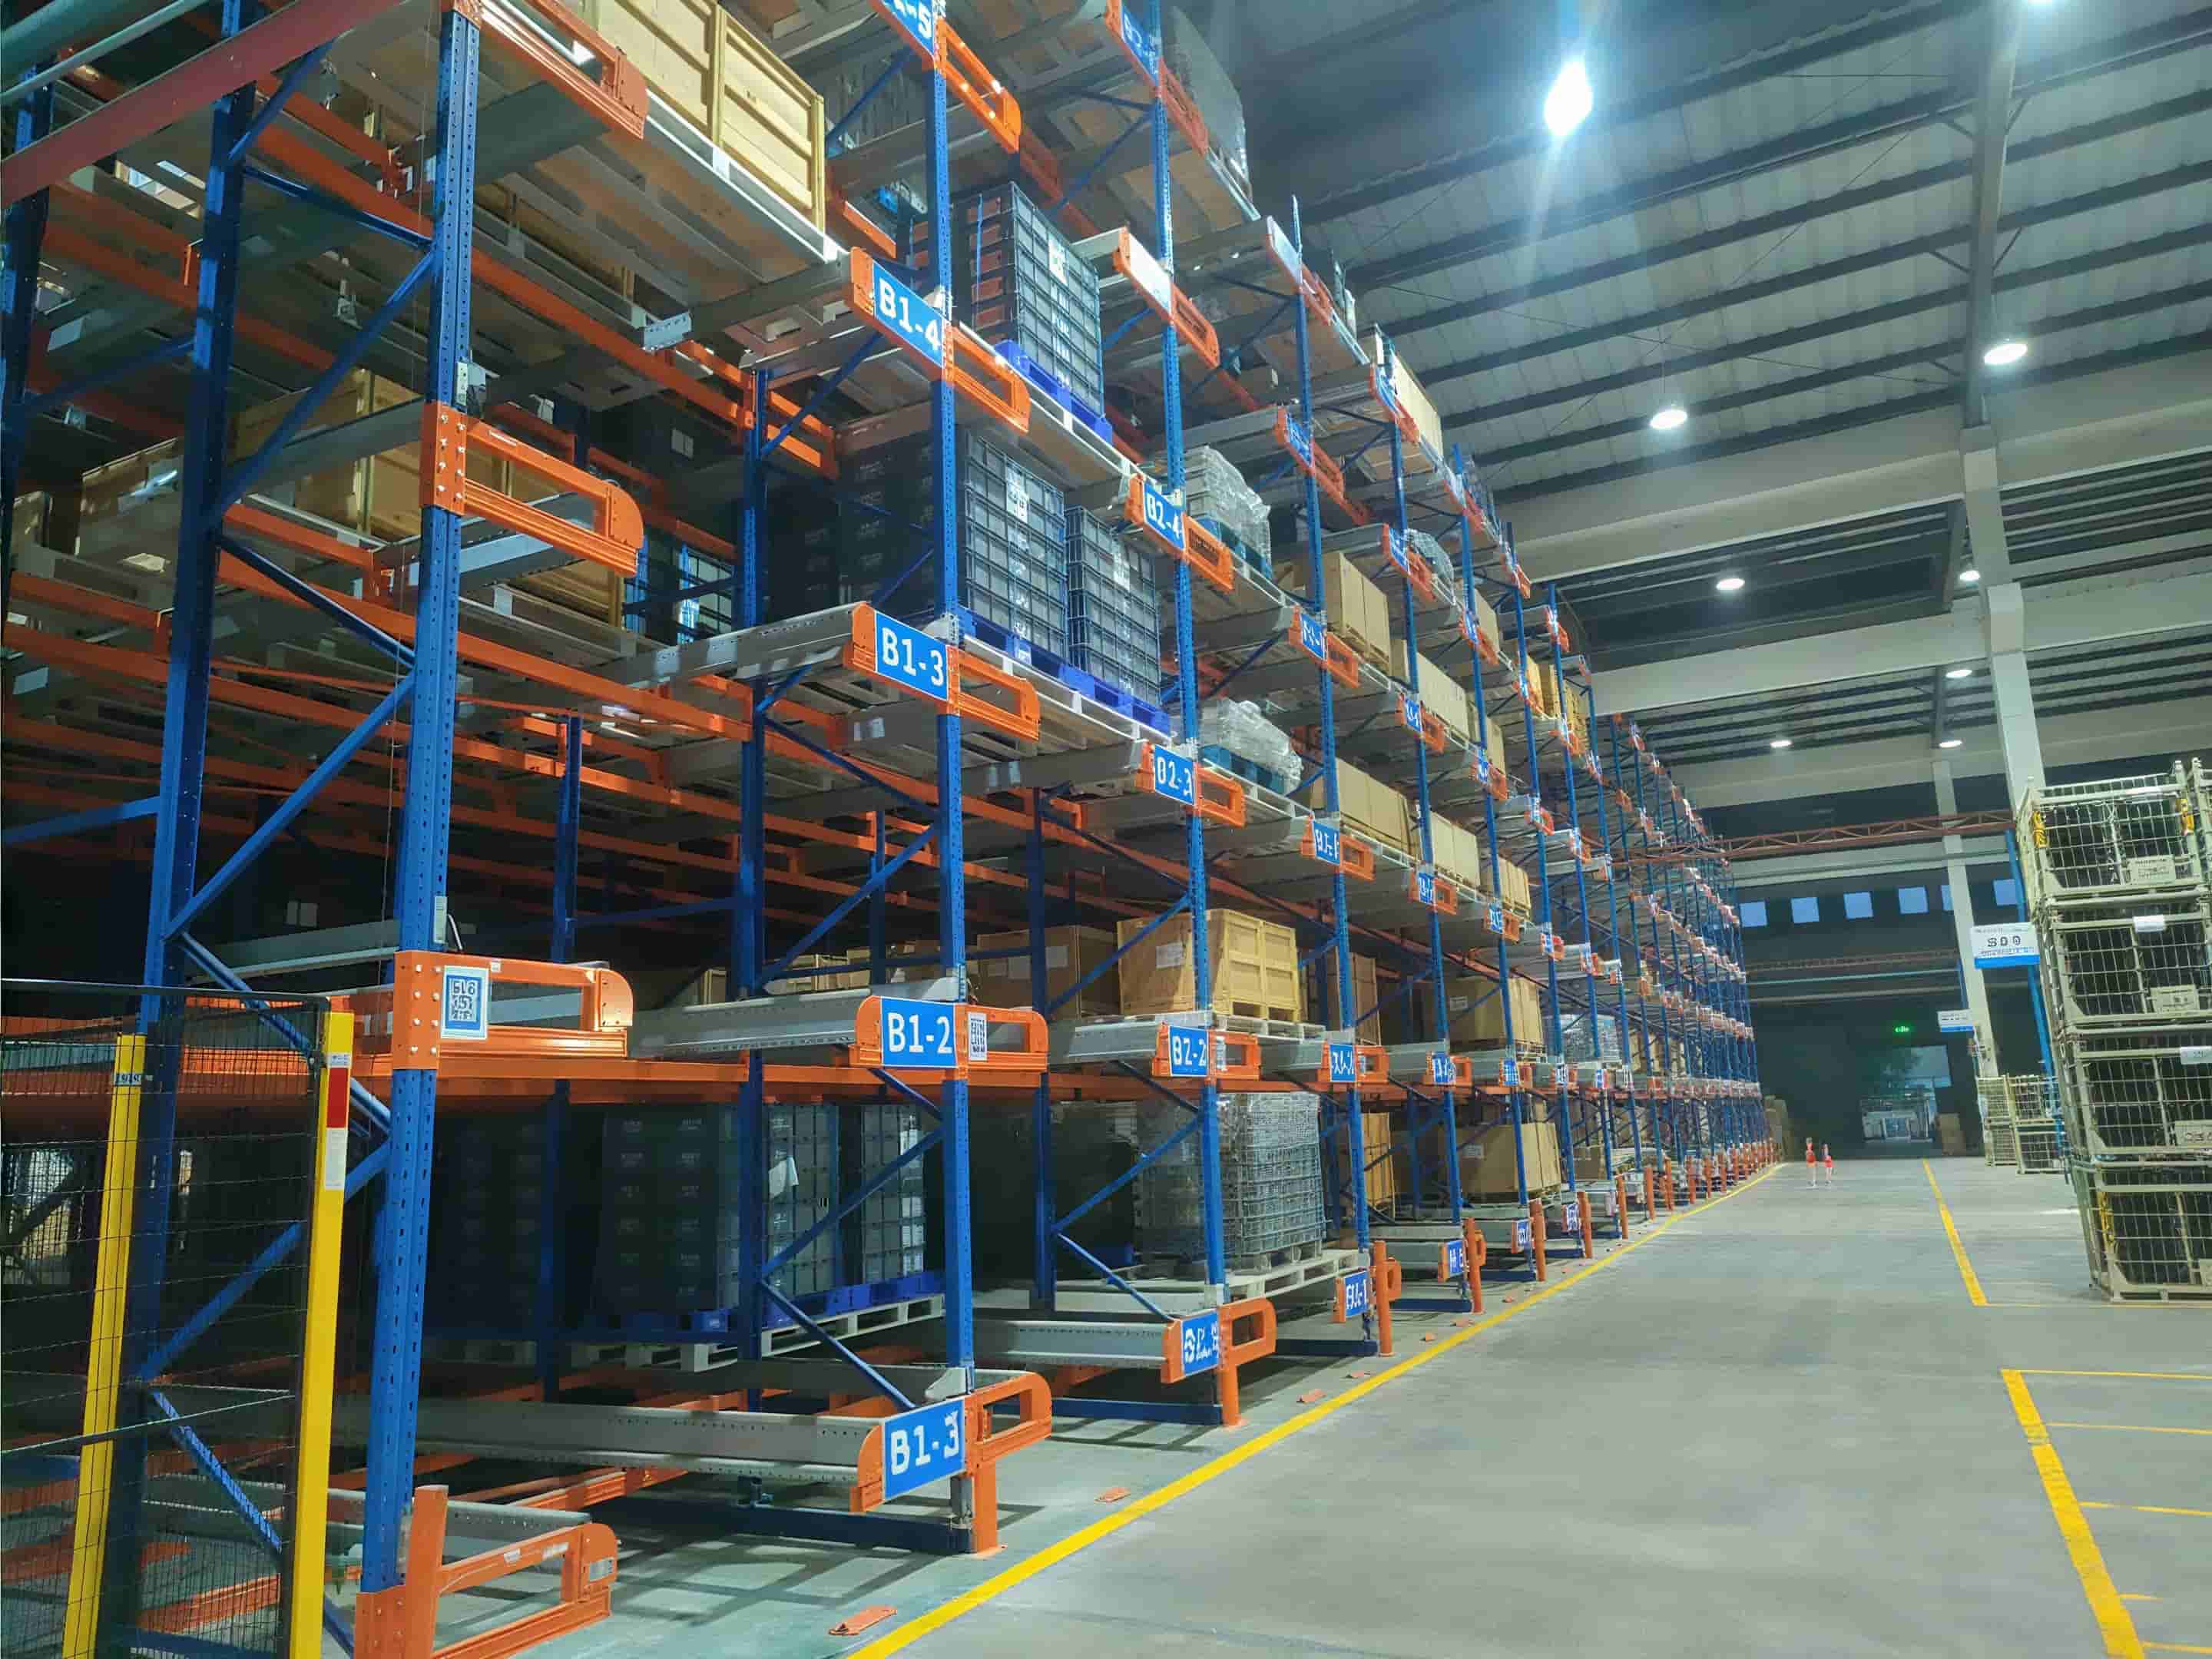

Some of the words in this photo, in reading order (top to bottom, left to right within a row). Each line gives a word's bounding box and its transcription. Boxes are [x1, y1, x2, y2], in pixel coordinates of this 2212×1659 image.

[879, 278, 942, 351] B1-4
[1147, 491, 1184, 541] B2-4
[882, 627, 944, 686] B1-3
[887, 1012, 952, 1054] B1-2
[1173, 1035, 1207, 1066] B2-2
